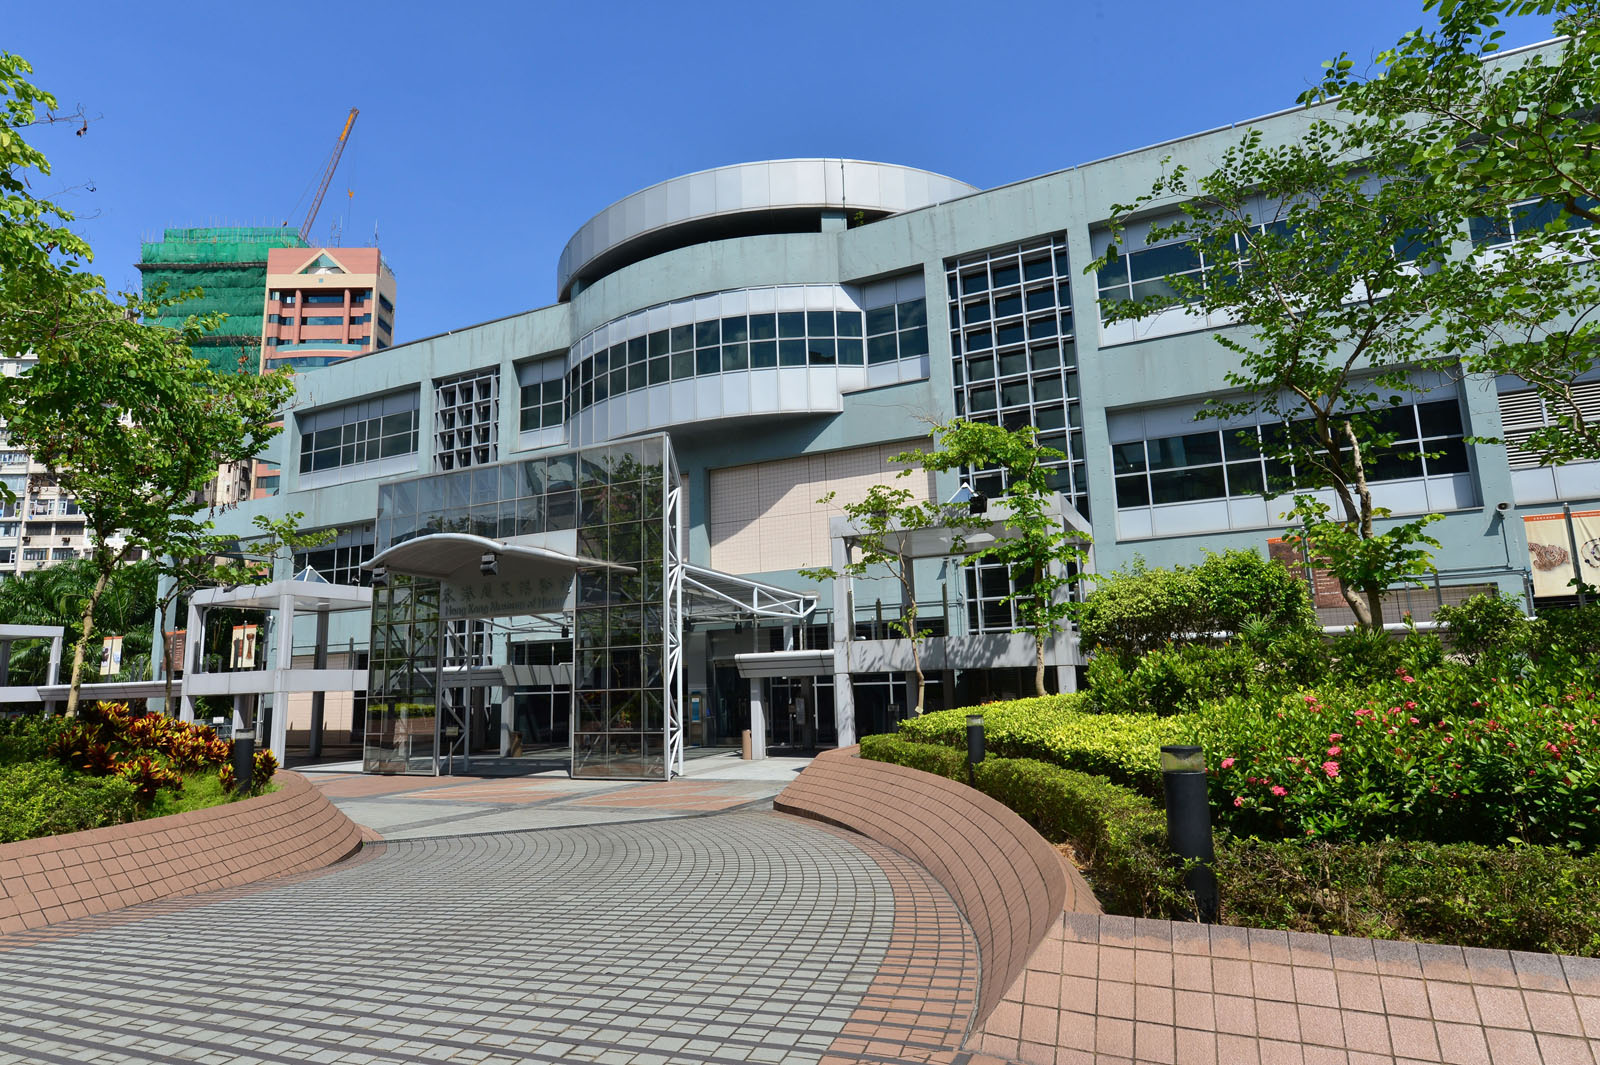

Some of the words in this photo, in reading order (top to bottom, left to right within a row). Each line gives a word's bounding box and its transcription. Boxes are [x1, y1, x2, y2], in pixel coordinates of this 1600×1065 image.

[445, 605, 466, 617] Hong
[468, 603, 489, 615] Kong
[527, 596, 537, 608] of
